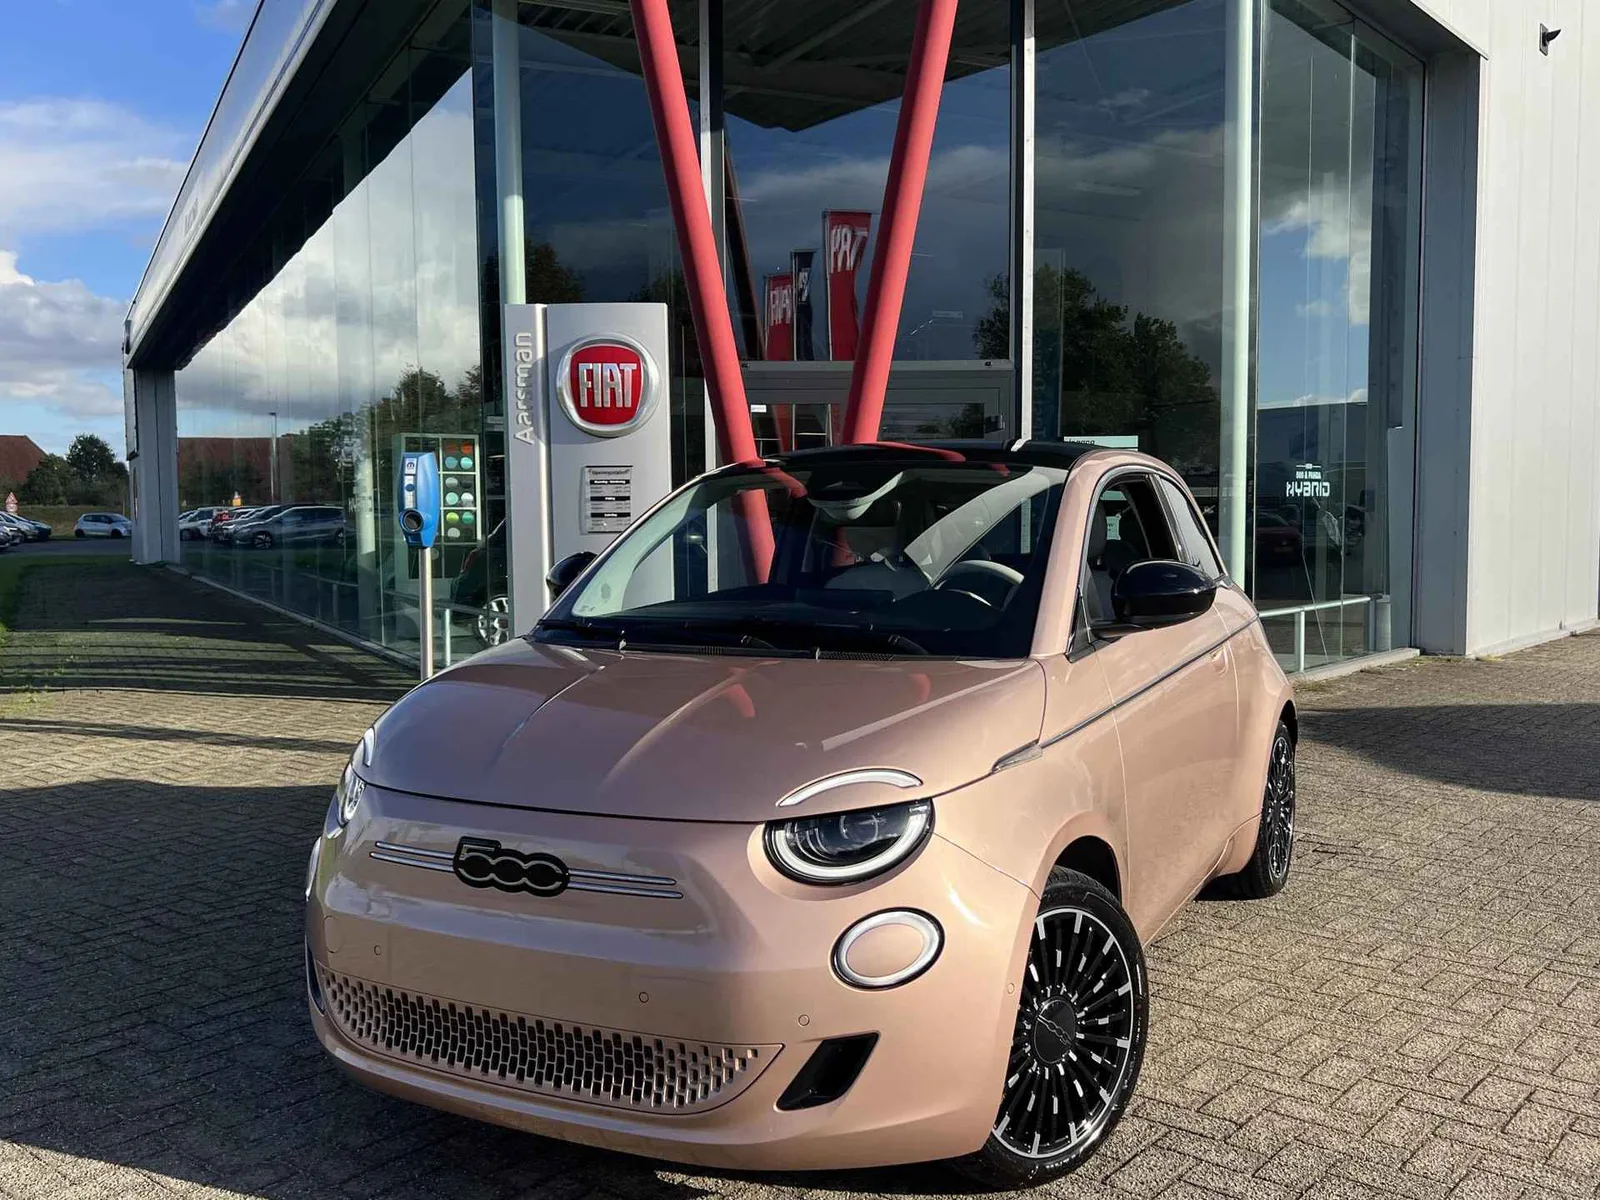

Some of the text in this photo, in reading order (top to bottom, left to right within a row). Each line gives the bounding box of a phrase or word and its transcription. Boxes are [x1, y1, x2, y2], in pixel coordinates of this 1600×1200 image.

[513, 332, 535, 445] Aarsman
[578, 362, 637, 408] FIAT
[1286, 481, 1330, 497] HYBRID
[454, 836, 570, 897] 500
